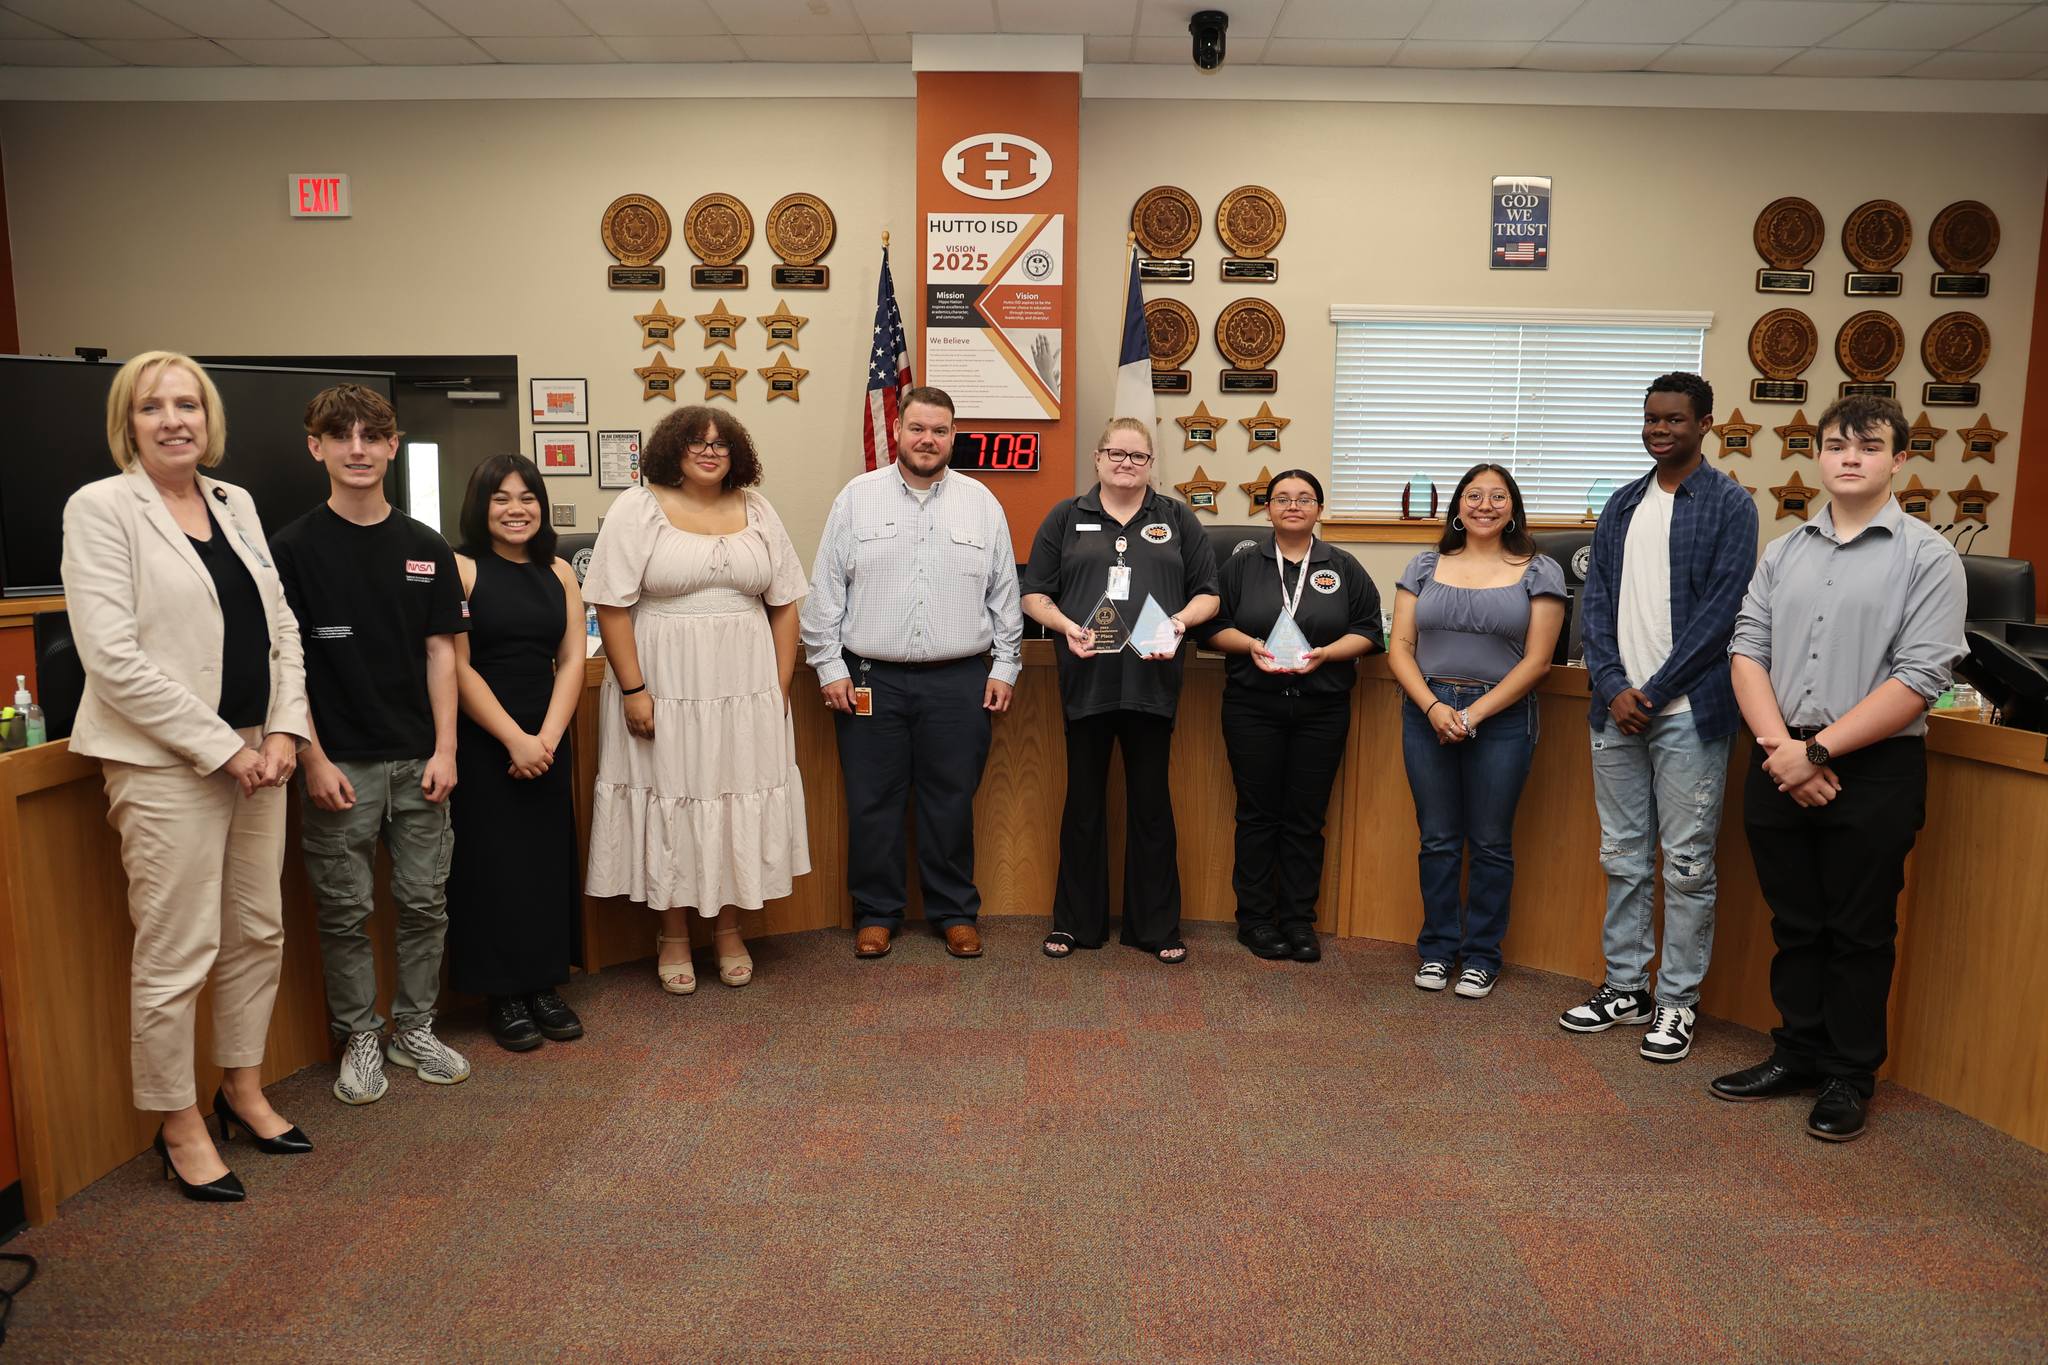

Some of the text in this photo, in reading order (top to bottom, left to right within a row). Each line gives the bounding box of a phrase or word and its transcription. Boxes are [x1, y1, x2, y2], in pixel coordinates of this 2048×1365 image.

[1511, 181, 1529, 193] IN
[298, 178, 341, 213] EXIT
[1501, 194, 1539, 208] GOD
[1507, 209, 1533, 221] WE
[930, 220, 1018, 233] HUTTO ISD
[1494, 223, 1547, 236] TRUST
[946, 245, 976, 253] VISION
[932, 253, 989, 271] 2025
[936, 291, 965, 299] Mission
[1015, 292, 1039, 300] Vision
[943, 337, 970, 345] Believe
[408, 562, 433, 572] NASA
